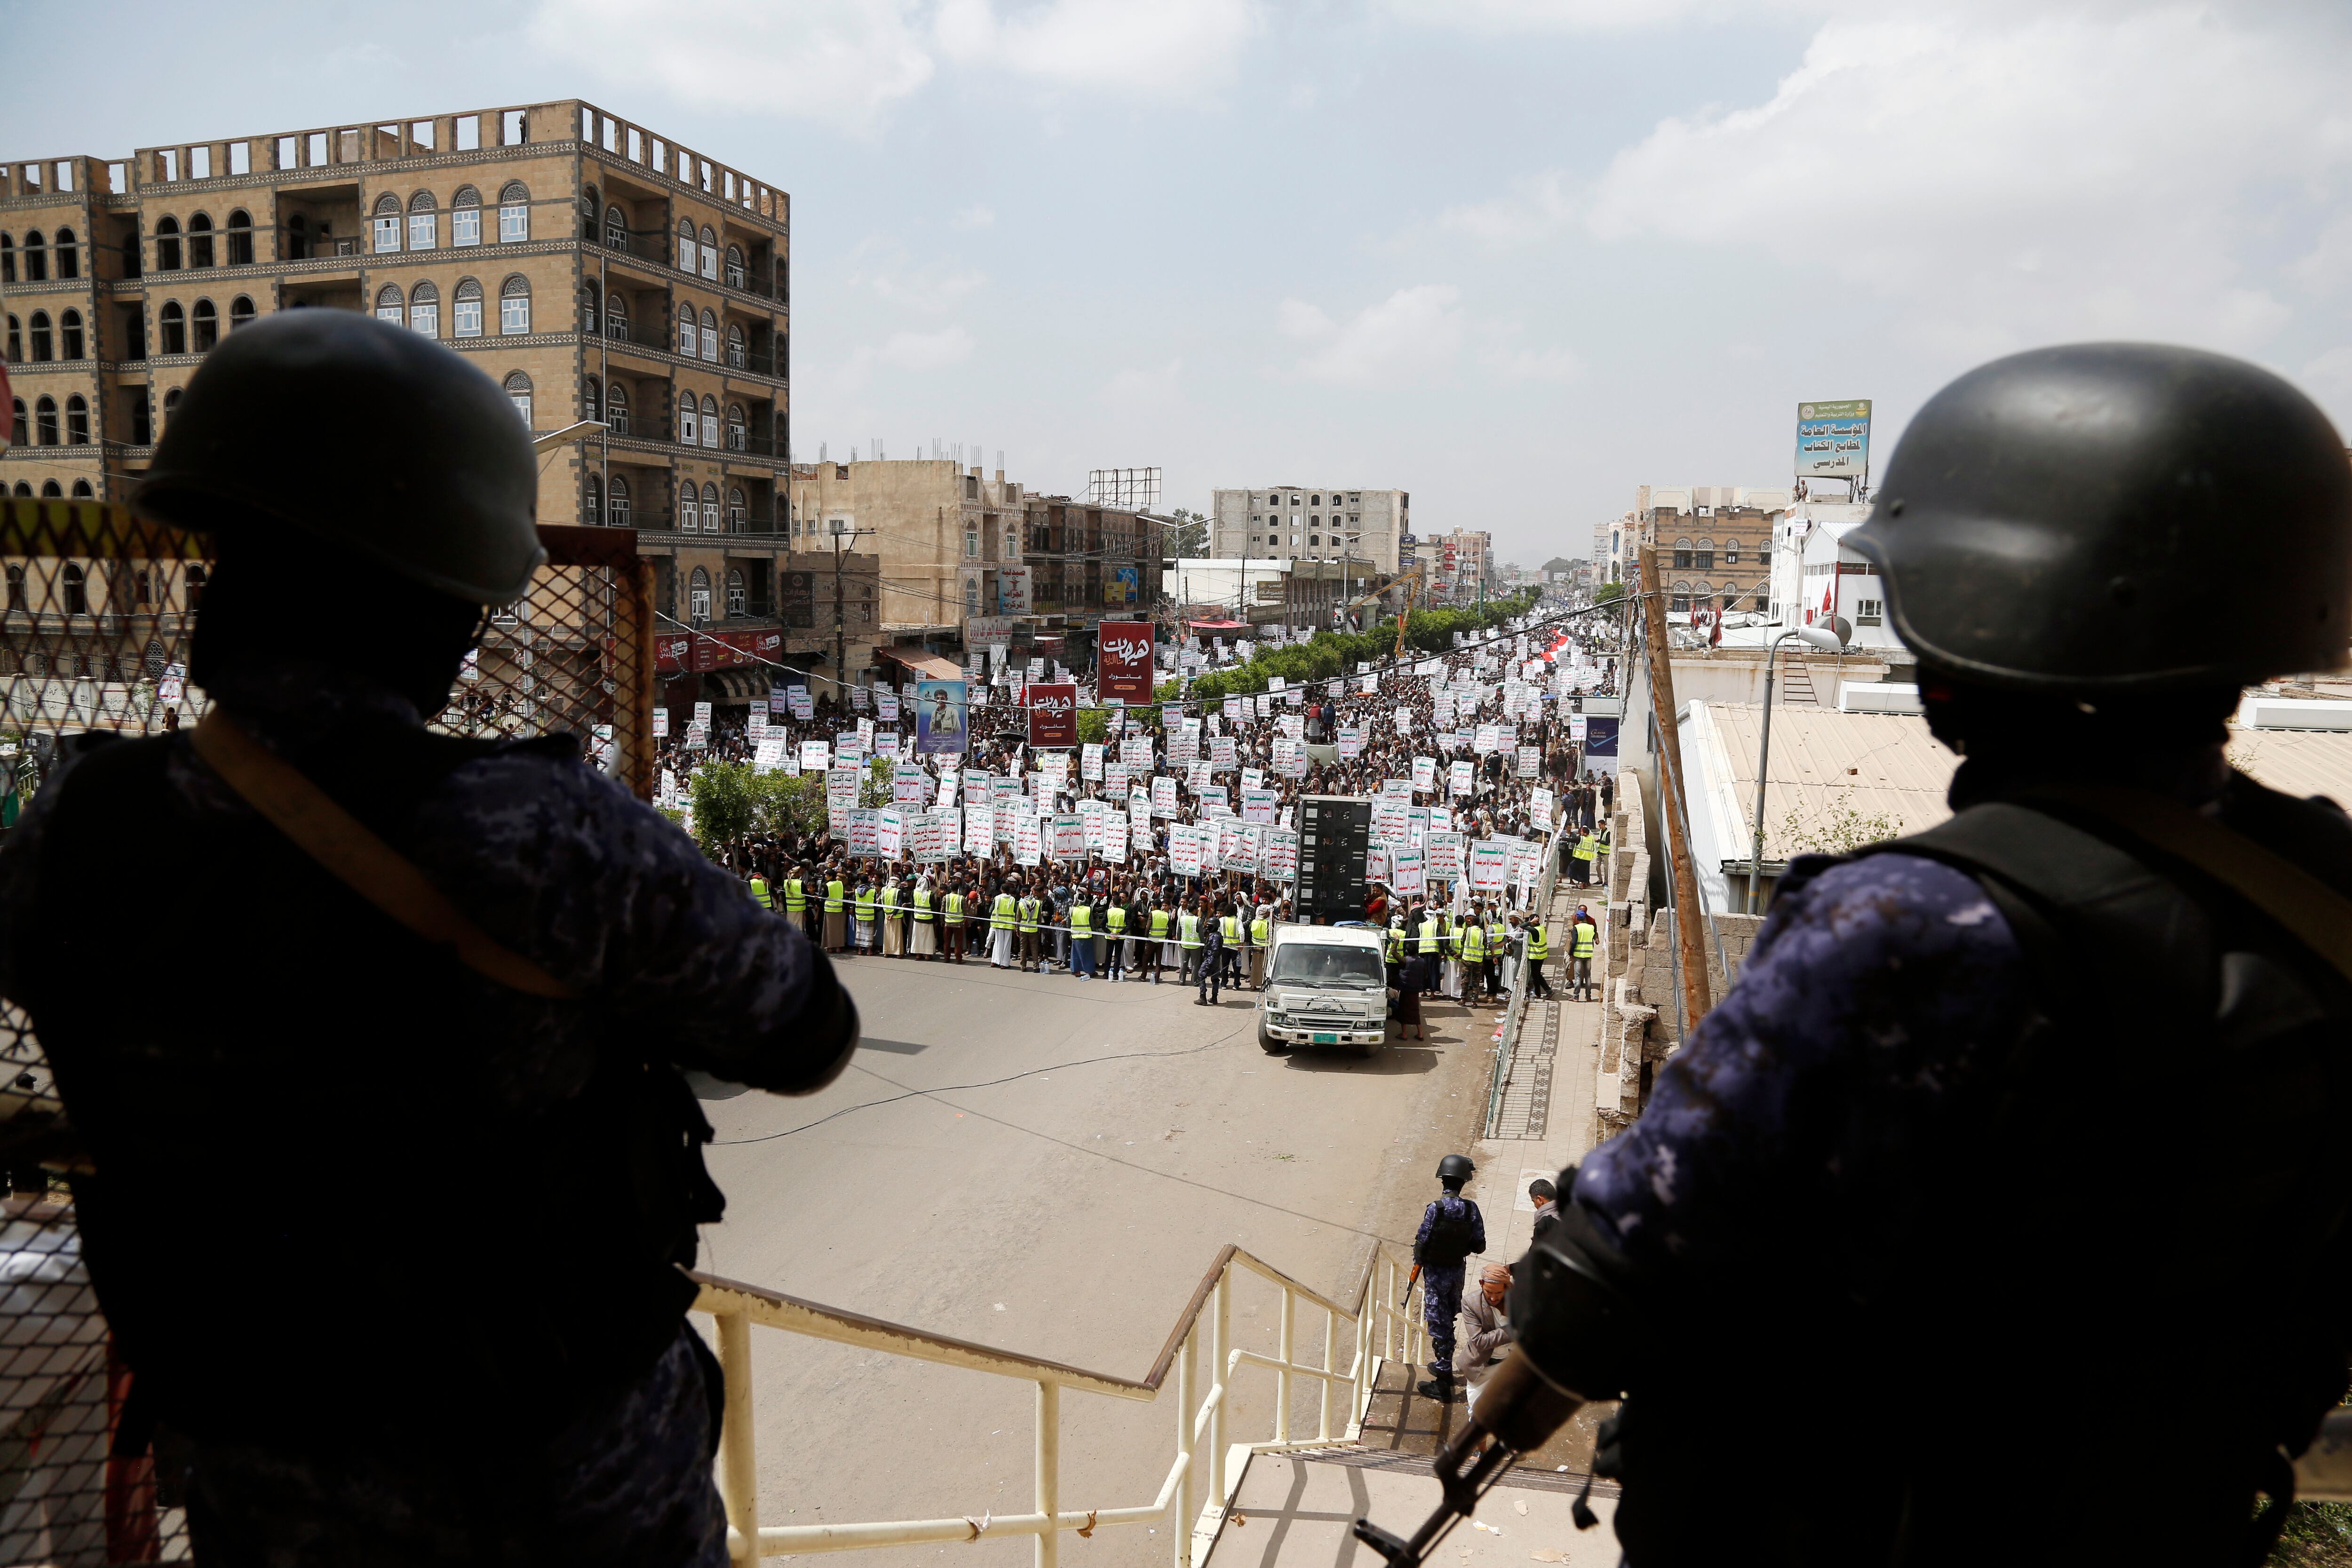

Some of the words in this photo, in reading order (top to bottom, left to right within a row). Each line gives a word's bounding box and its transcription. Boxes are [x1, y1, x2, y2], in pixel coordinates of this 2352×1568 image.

[1801, 425, 1828, 437] العامة
[1831, 424, 1866, 437] المؤسسة
[1804, 440, 1833, 453] الكتاب
[1836, 440, 1860, 453] لمطابع
[1813, 456, 1849, 471] المدرسي
[1002, 568, 1025, 577] صيدلية
[1003, 600, 1025, 609] المركزية
[970, 624, 979, 641] المركزية
[980, 622, 994, 640] الجراف
[995, 619, 1011, 640] صيدلية
[1103, 637, 1149, 666] هيهات
[1104, 653, 1116, 665] الذلة
[1034, 695, 1071, 718] هيهات
[830, 774, 844, 783] أكبر
[967, 774, 985, 782] قاطعوا
[995, 781, 1017, 790] قاطعوا
[1387, 784, 1404, 794] أكبر
[1202, 790, 1223, 798] قاطعوا
[1380, 805, 1399, 814] أكبر
[851, 812, 866, 822] أكبر
[913, 817, 930, 829] أكبر
[1055, 818, 1081, 828] قاطعوا
[1175, 829, 1188, 839] أكبر
[1271, 834, 1287, 844] أكبر
[1430, 835, 1446, 845] أكبر
[1476, 845, 1504, 855] قاطعوا
[1373, 853, 1385, 863] البضائع
[1397, 852, 1419, 863] قاطعوا
[1475, 858, 1490, 866] الأمريكية
[1490, 859, 1503, 867] البضائع
[1398, 882, 1420, 891] الإسرائيلية
[1475, 877, 1502, 886] الإسرائيلية
